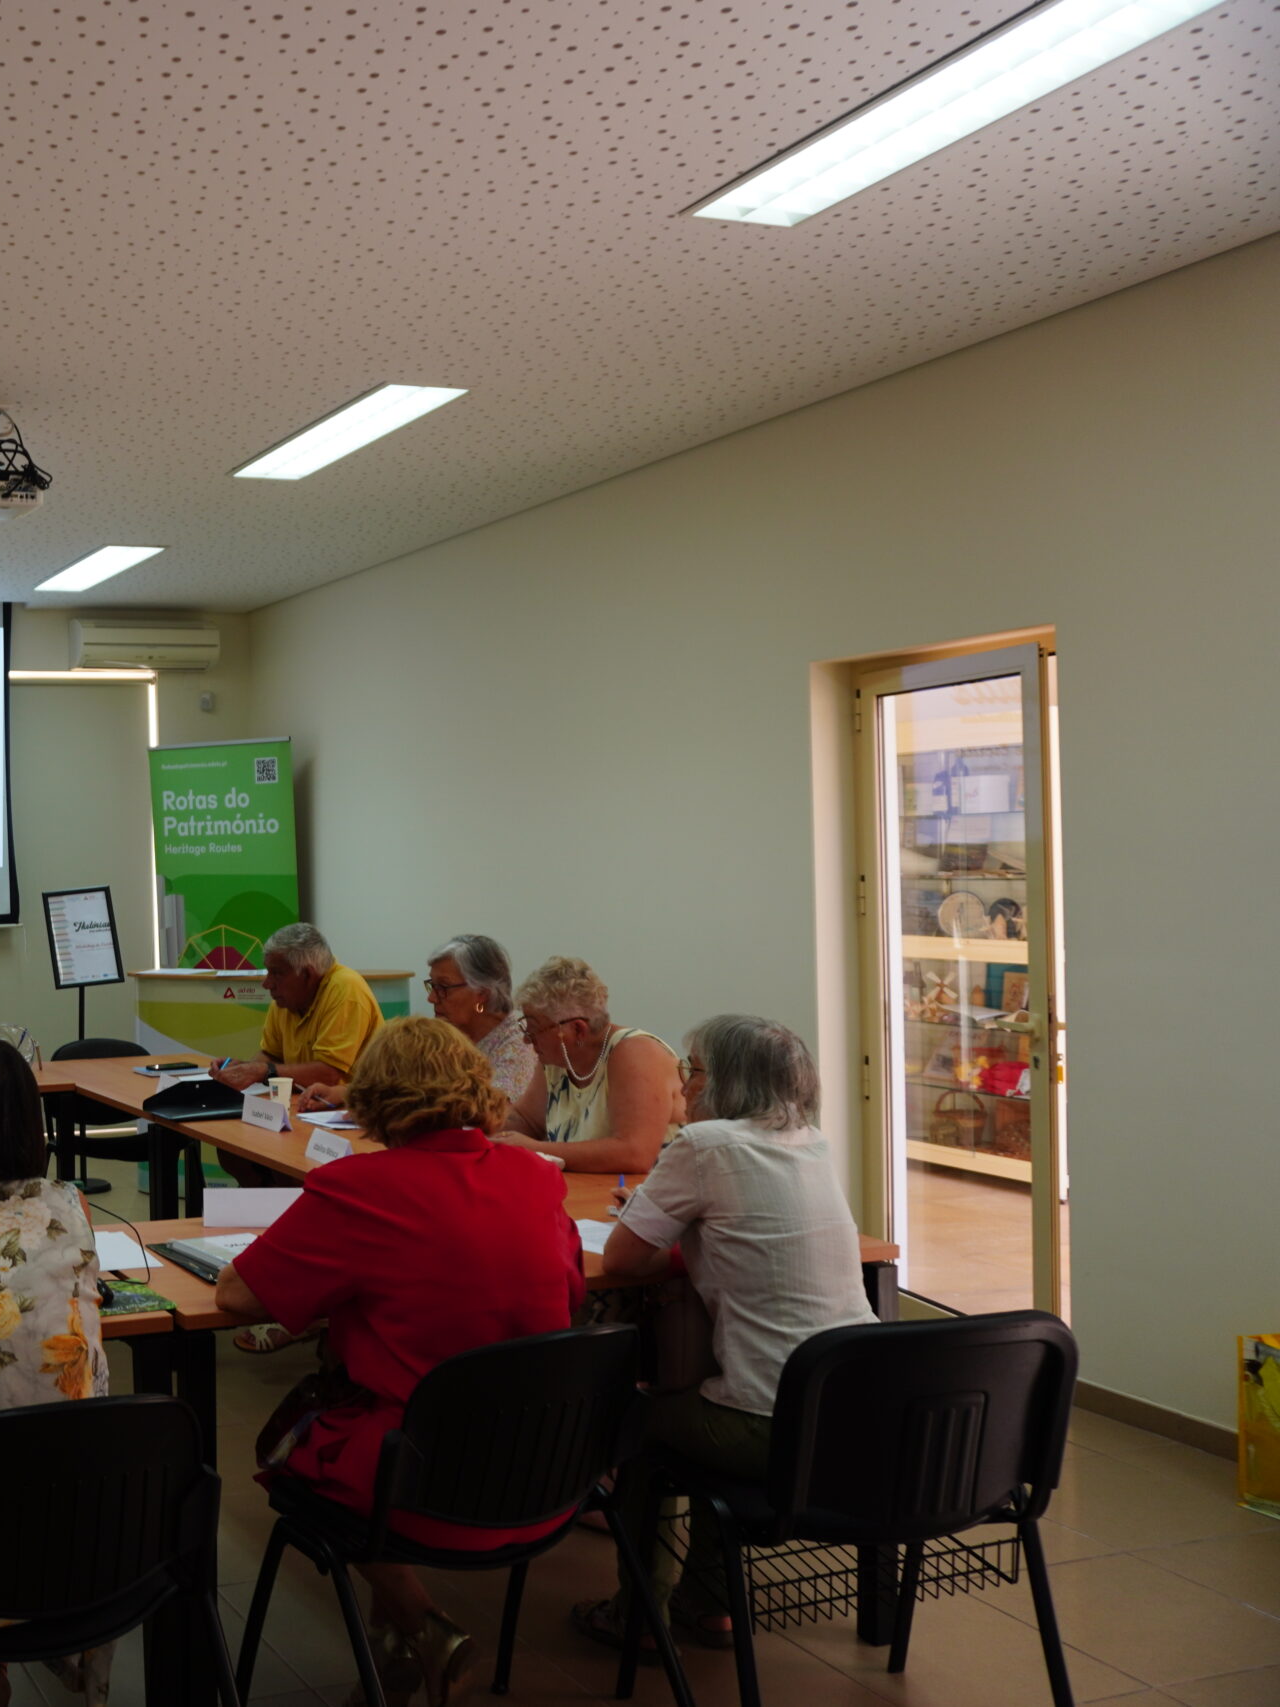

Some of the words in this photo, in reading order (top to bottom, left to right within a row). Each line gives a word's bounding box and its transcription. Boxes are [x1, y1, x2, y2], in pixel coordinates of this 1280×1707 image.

[162, 789, 218, 811] Rotas
[224, 787, 250, 809] do
[163, 813, 279, 837] Património
[164, 844, 206, 856] Heritage
[208, 842, 242, 853] Routes
